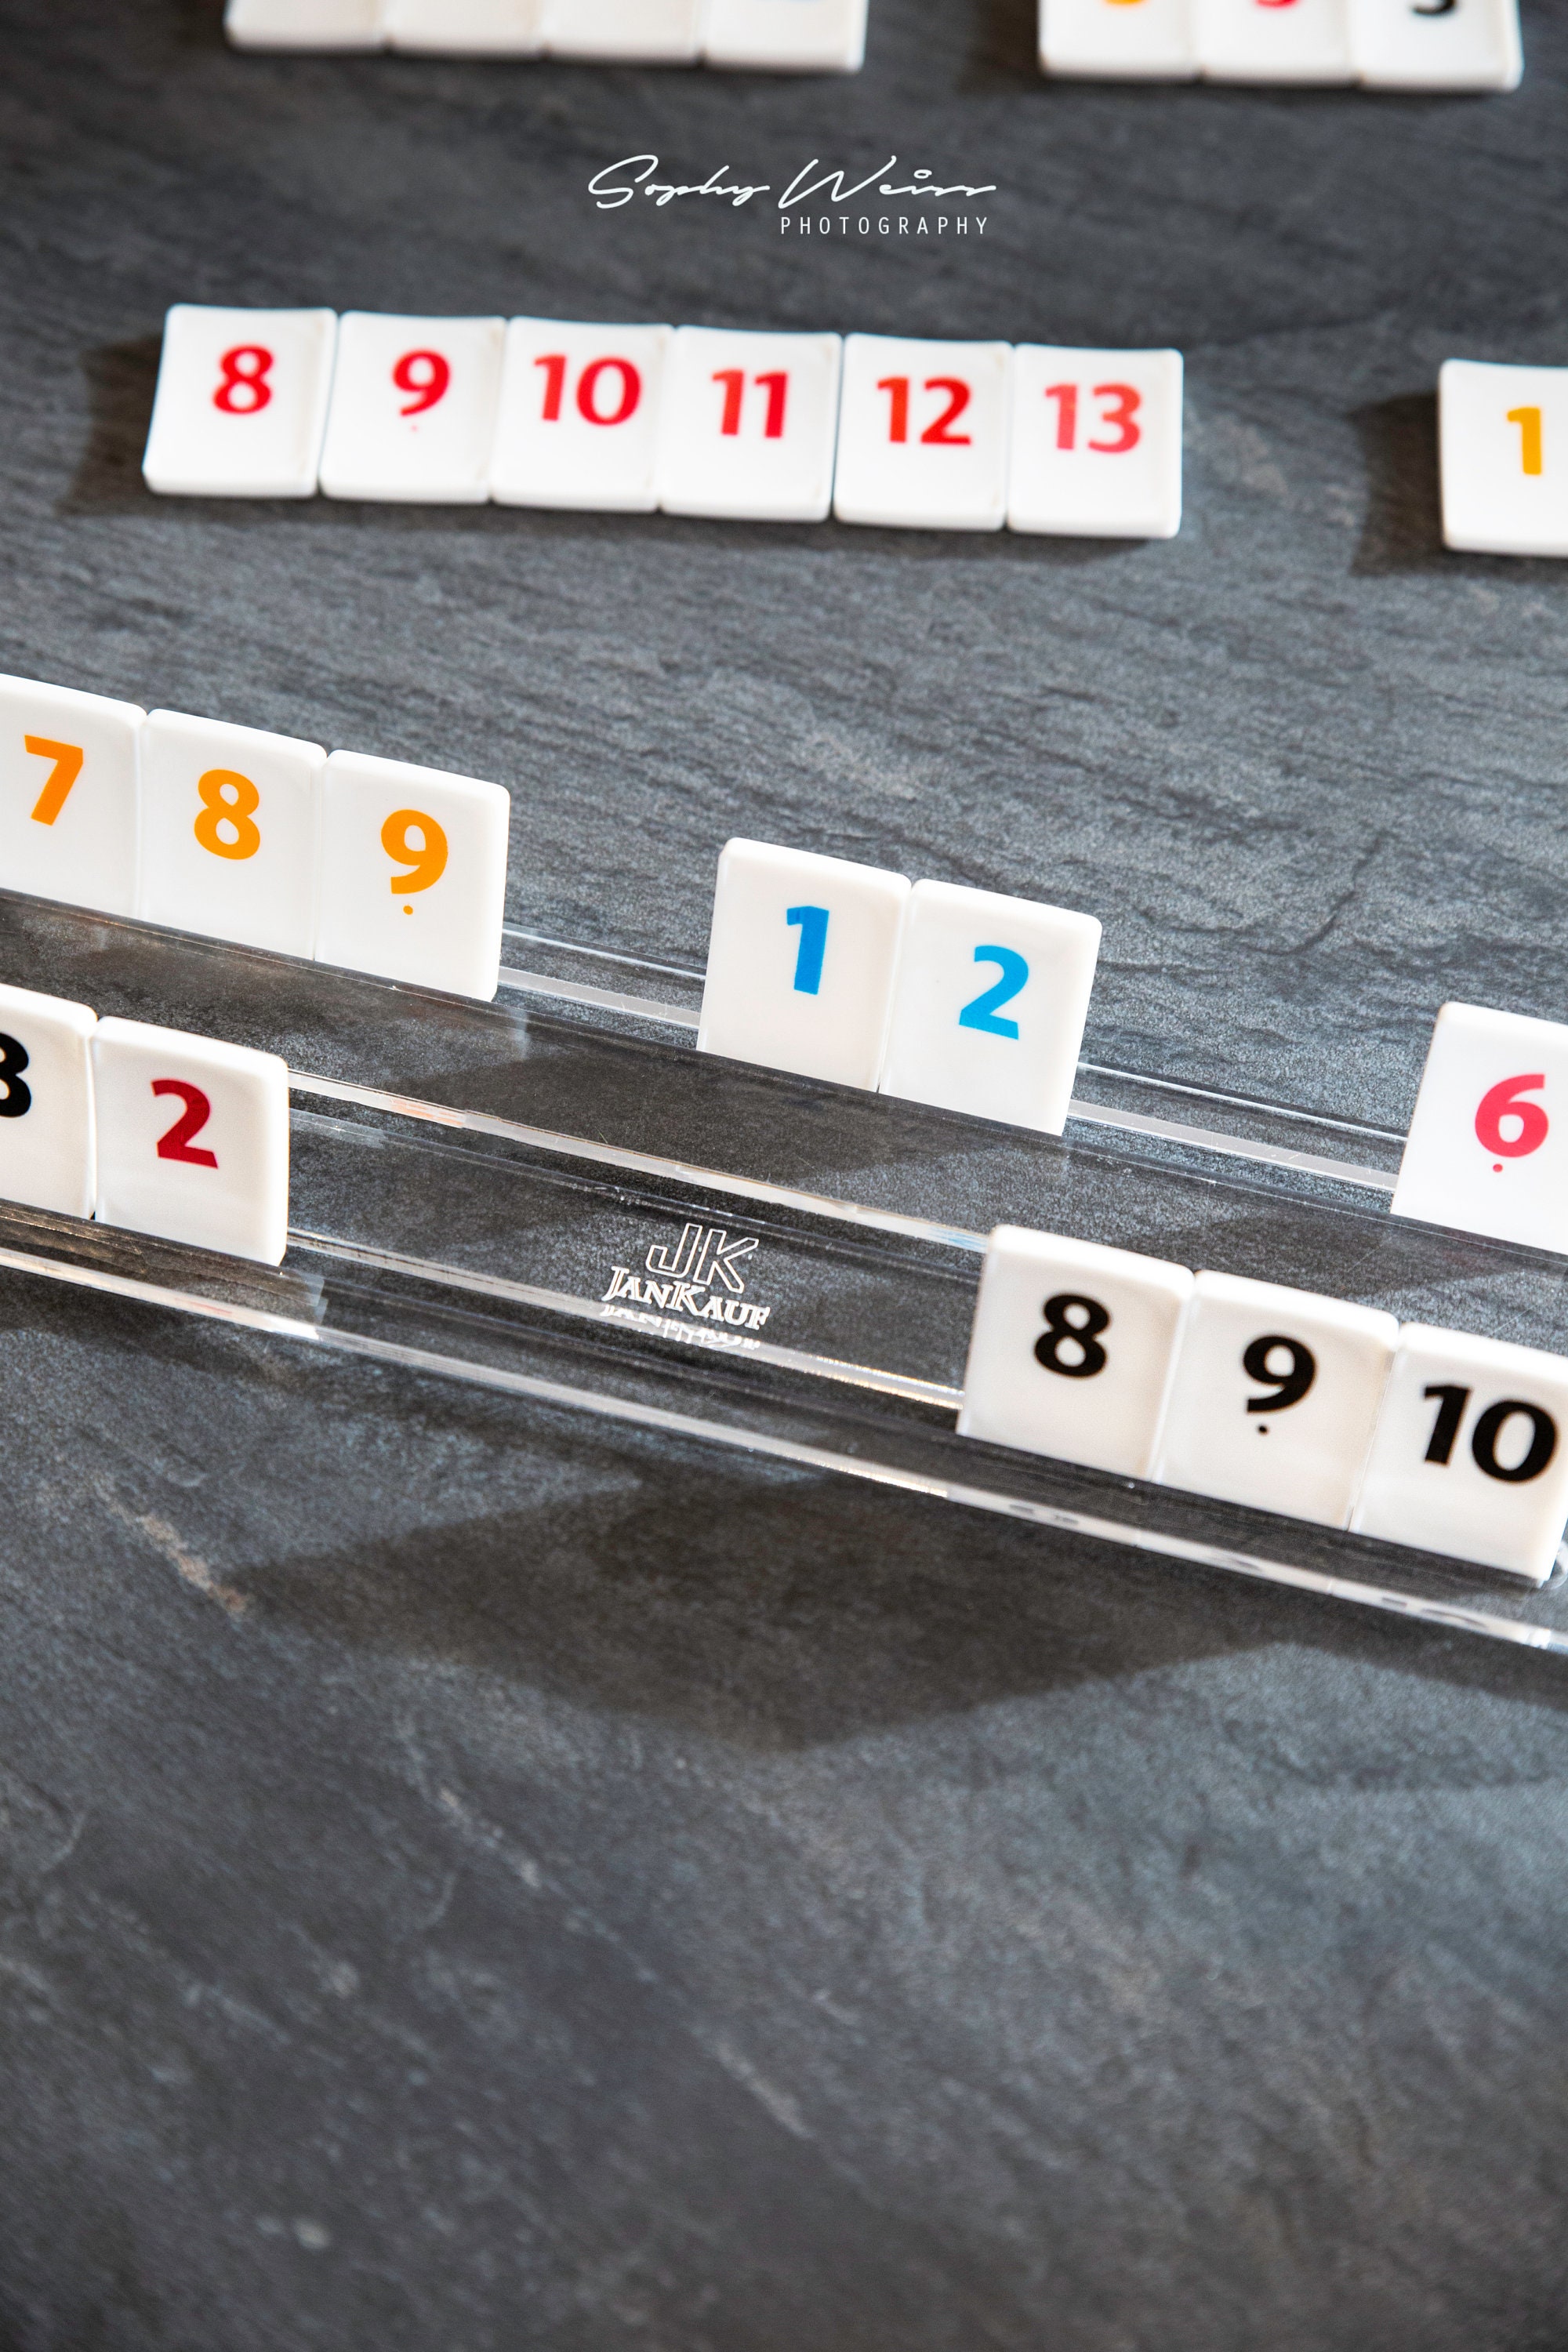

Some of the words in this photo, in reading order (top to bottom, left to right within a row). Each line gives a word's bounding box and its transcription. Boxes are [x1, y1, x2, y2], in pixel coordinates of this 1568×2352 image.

[212, 344, 274, 415] 8
[392, 350, 451, 417] 9
[535, 354, 642, 426] 10
[712, 369, 789, 439] 11
[877, 376, 971, 446] 12
[1045, 383, 1142, 453] 13
[1505, 405, 1544, 477] 1
[24, 734, 84, 826] 7
[193, 768, 261, 861] 8
[380, 808, 449, 895] 9
[786, 906, 830, 996] 1
[958, 945, 1029, 1040] 2
[150, 1078, 219, 1169] 2
[1475, 1074, 1548, 1158] 6
[645, 1222, 760, 1294] JK
[1033, 1294, 1110, 1378] 8
[1242, 1334, 1316, 1414] 9
[1422, 1384, 1559, 1484] 10
